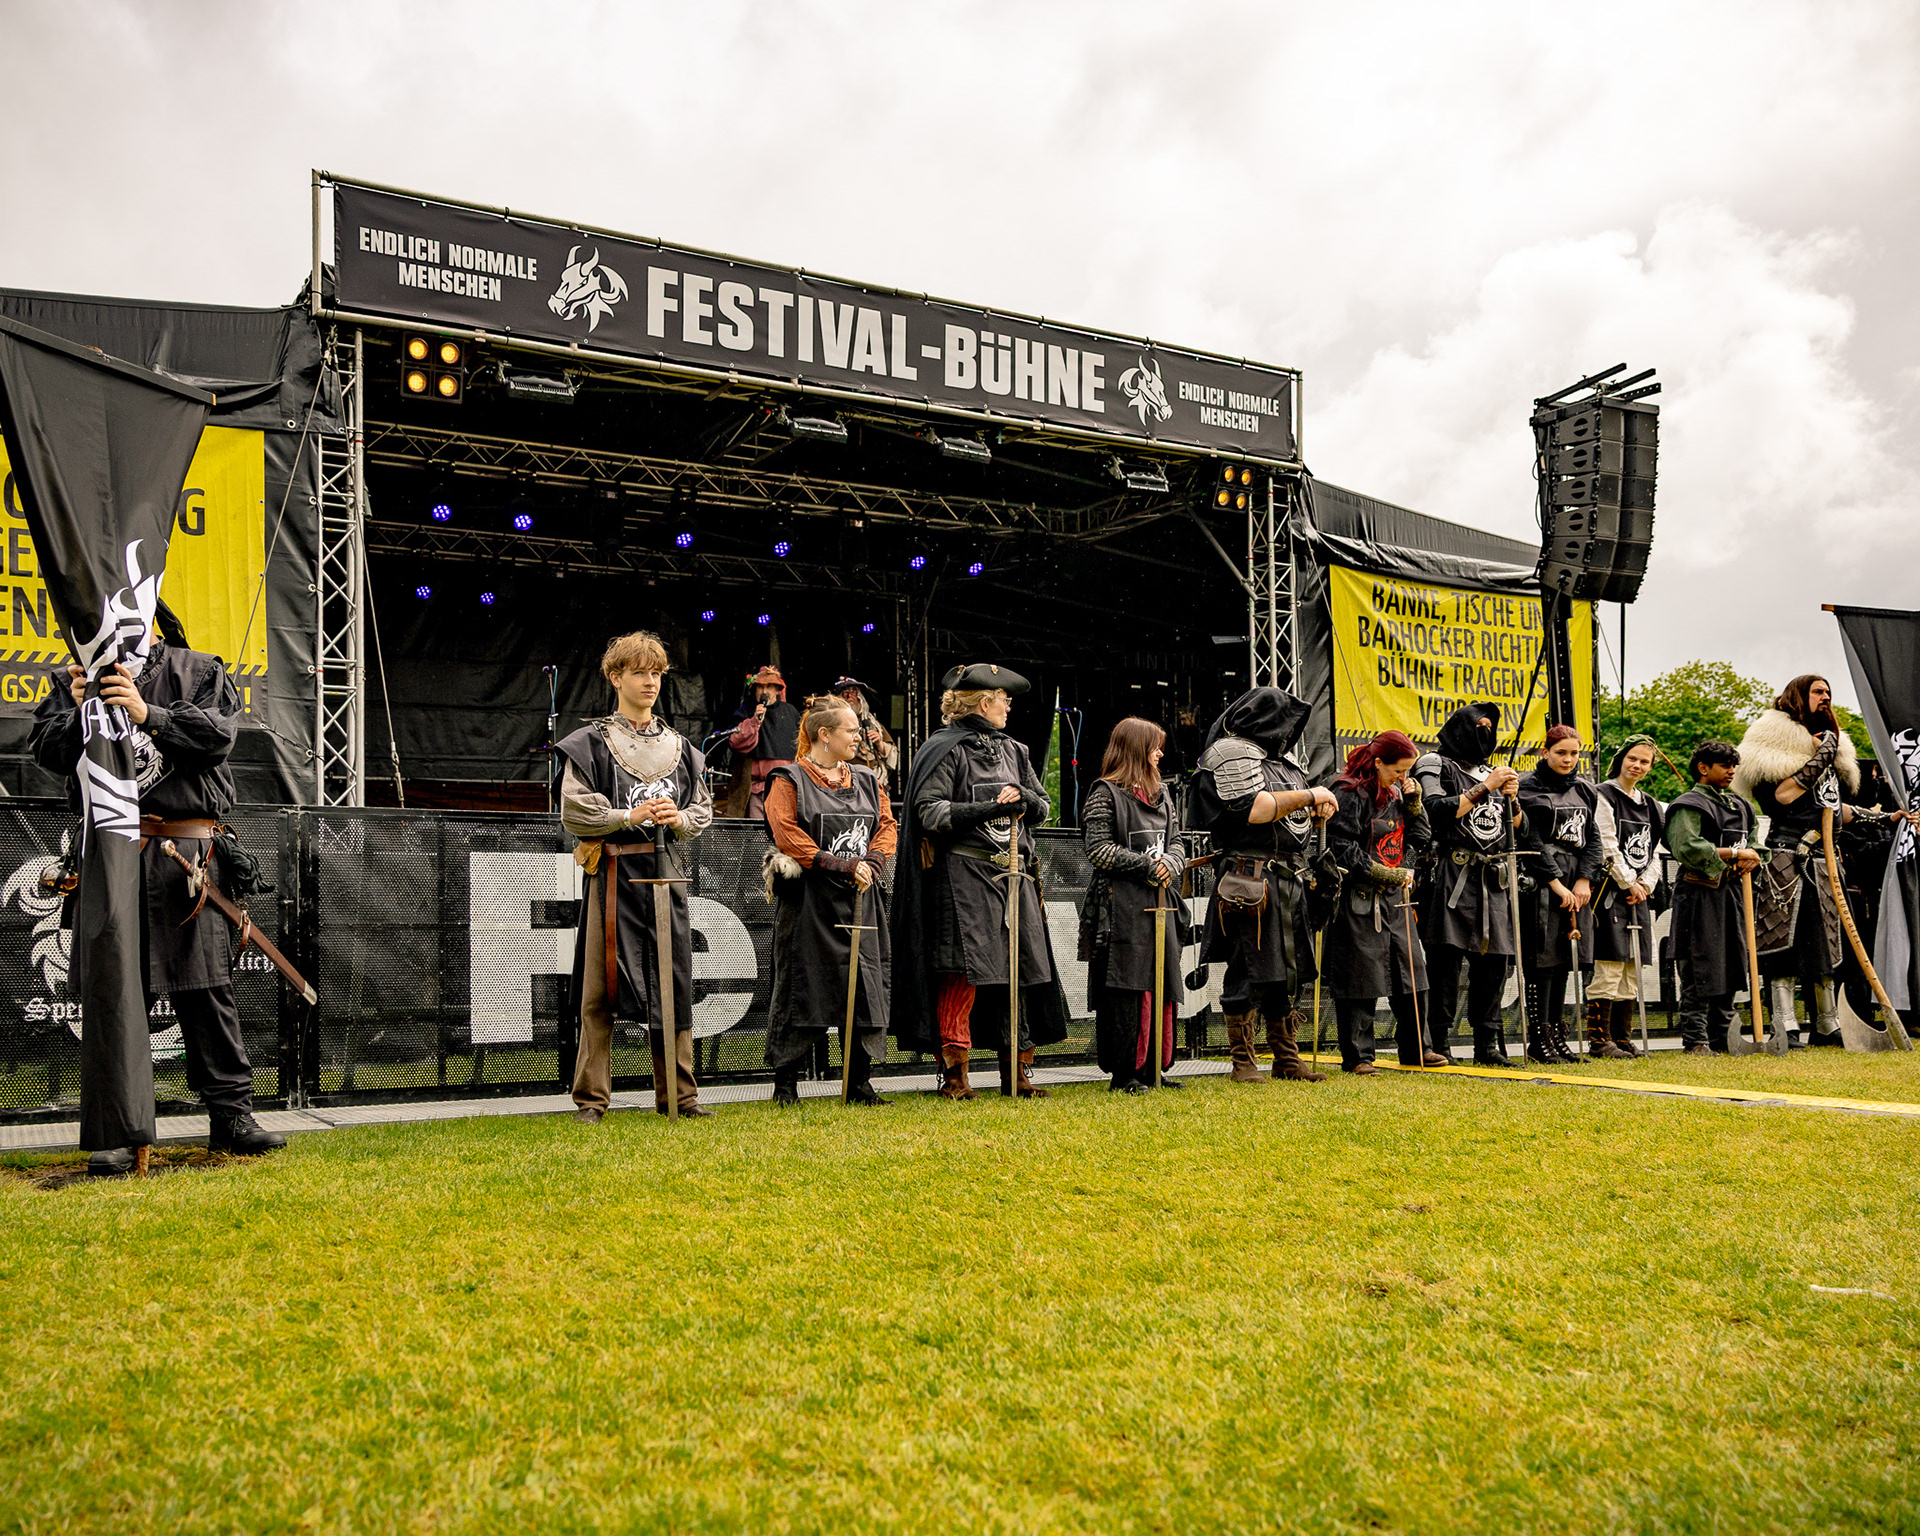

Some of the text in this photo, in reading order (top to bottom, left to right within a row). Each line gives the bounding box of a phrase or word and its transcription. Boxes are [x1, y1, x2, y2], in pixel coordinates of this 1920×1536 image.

[359, 226, 537, 281] ENDLICH NORMALE
[398, 261, 502, 302] MENSCHEN
[647, 265, 1105, 413] FESTIVAL-BÜHNE
[1178, 380, 1279, 417] ENDLICH NORMALE
[1200, 405, 1259, 433] MENSCHEN
[1372, 579, 1544, 632] BÄNKE, TISCHE UN
[1358, 615, 1547, 666] BARHOCKER RICHTU
[1378, 651, 1549, 700] BÜHNE TRAGEN IS
